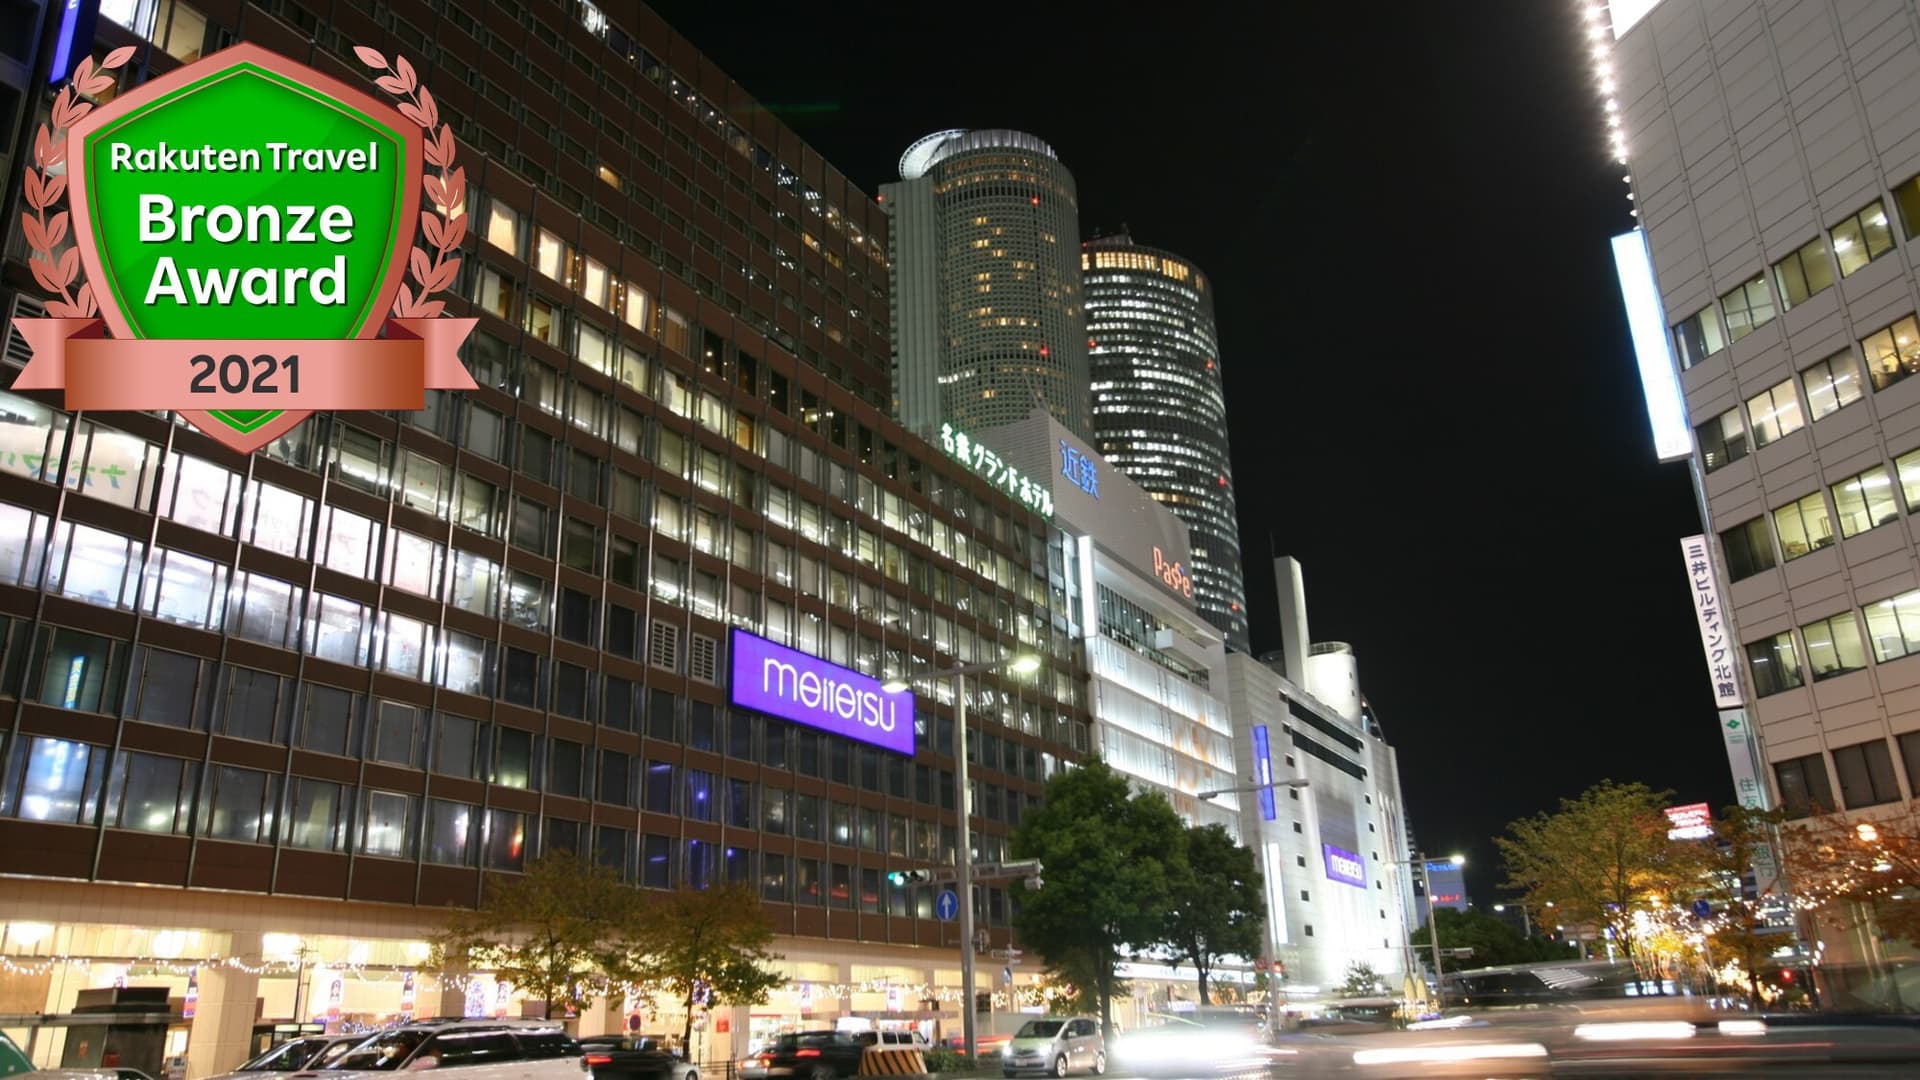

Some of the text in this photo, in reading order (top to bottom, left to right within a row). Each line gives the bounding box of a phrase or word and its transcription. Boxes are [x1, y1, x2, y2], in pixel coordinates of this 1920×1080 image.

[1060, 439, 1100, 501] 近鉄
[1688, 544, 1736, 698] 三井ビルディング北館
[763, 657, 895, 732] meitetsu
